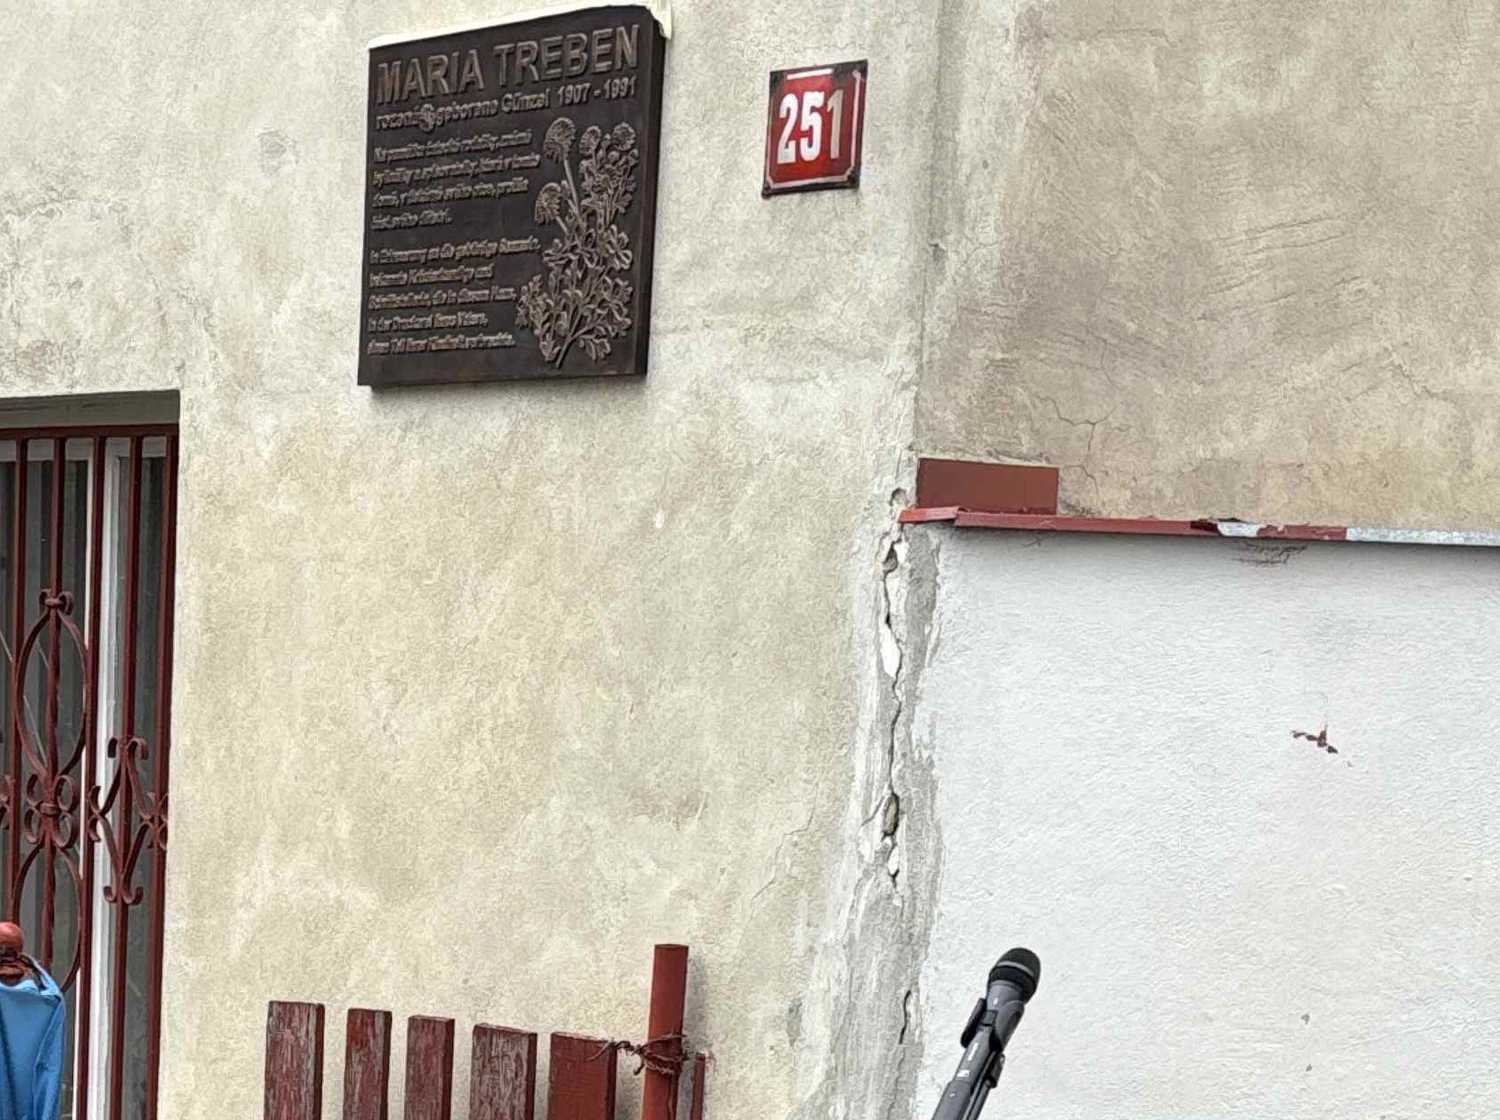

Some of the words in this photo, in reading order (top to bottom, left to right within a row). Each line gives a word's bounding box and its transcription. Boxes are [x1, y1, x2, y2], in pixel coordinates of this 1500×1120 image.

[376, 49, 485, 103] MARIA
[493, 24, 639, 87] TREBEN
[557, 83, 591, 106] 1907
[604, 75, 636, 98] 1991
[777, 89, 844, 164] 251
